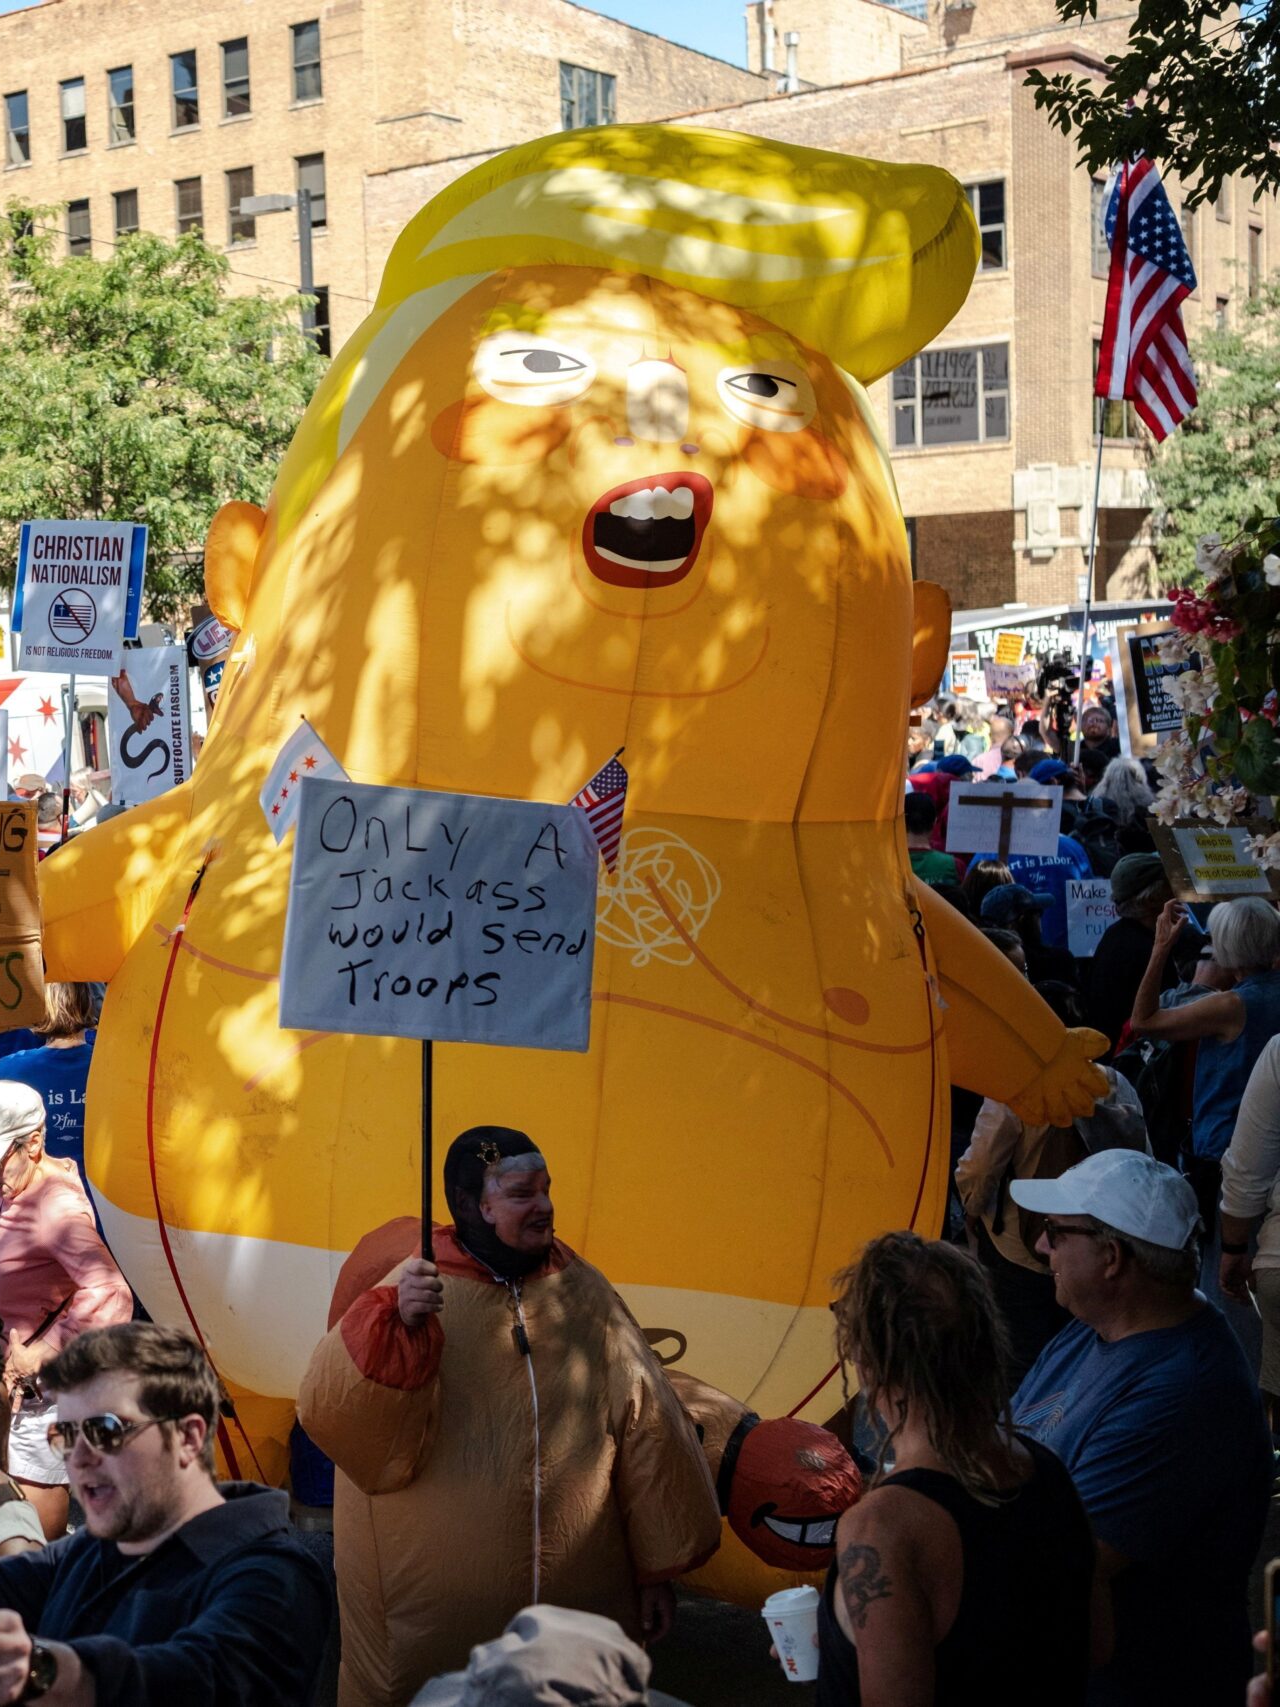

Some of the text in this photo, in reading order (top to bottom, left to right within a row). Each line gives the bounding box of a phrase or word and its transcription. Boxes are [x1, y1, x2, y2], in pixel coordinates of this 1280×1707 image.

[34, 535, 124, 561] CHRISTIAN
[31, 564, 121, 586] NATIONALISM
[197, 622, 231, 653] LIE
[25, 646, 32, 655] IS
[33, 646, 45, 656] NOT
[47, 647, 79, 658] RELIGIOUS
[170, 664, 184, 785] SUFFOCATE FASCISM
[525, 823, 568, 869] A
[1025, 857, 1035, 868] is
[1072, 883, 1106, 899] Make
[328, 912, 453, 948] would
[1086, 920, 1107, 935] rul
[48, 1089, 63, 1105] is
